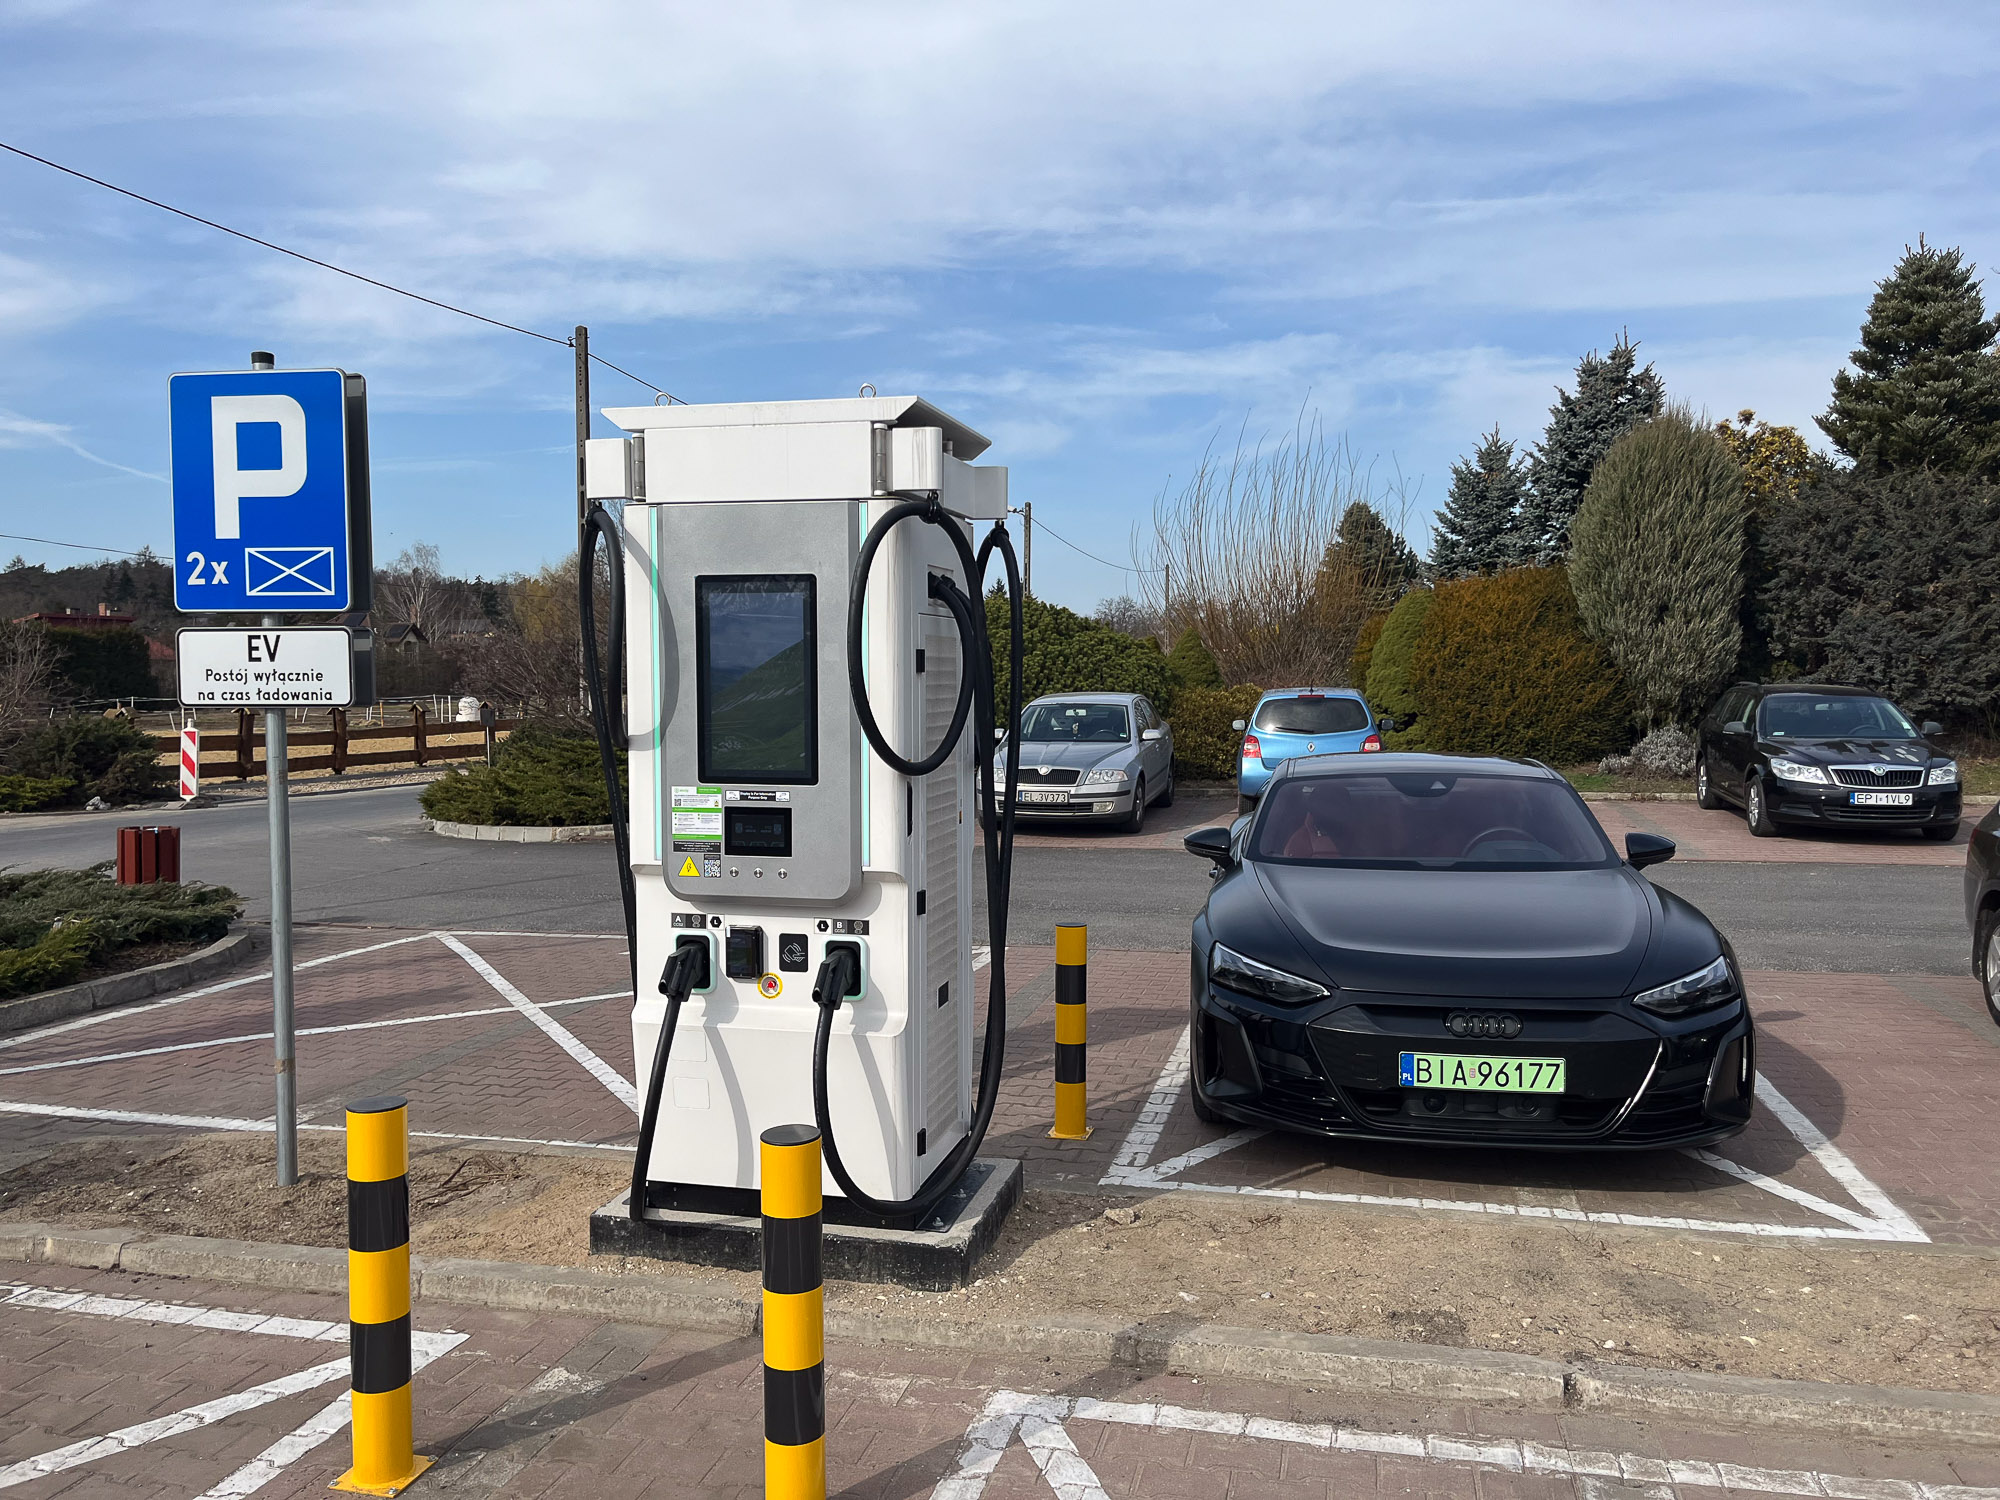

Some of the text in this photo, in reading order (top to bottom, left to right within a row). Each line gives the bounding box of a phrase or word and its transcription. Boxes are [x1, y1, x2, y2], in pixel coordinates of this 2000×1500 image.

[211, 394, 308, 540] P
[247, 634, 281, 663] EV
[205, 668, 324, 686] Postój wyłącznie
[197, 687, 333, 701] na czas ładowania
[1038, 793, 1066, 803] 3V373
[836, 921, 843, 929] B
[1402, 1073, 1413, 1081] PL
